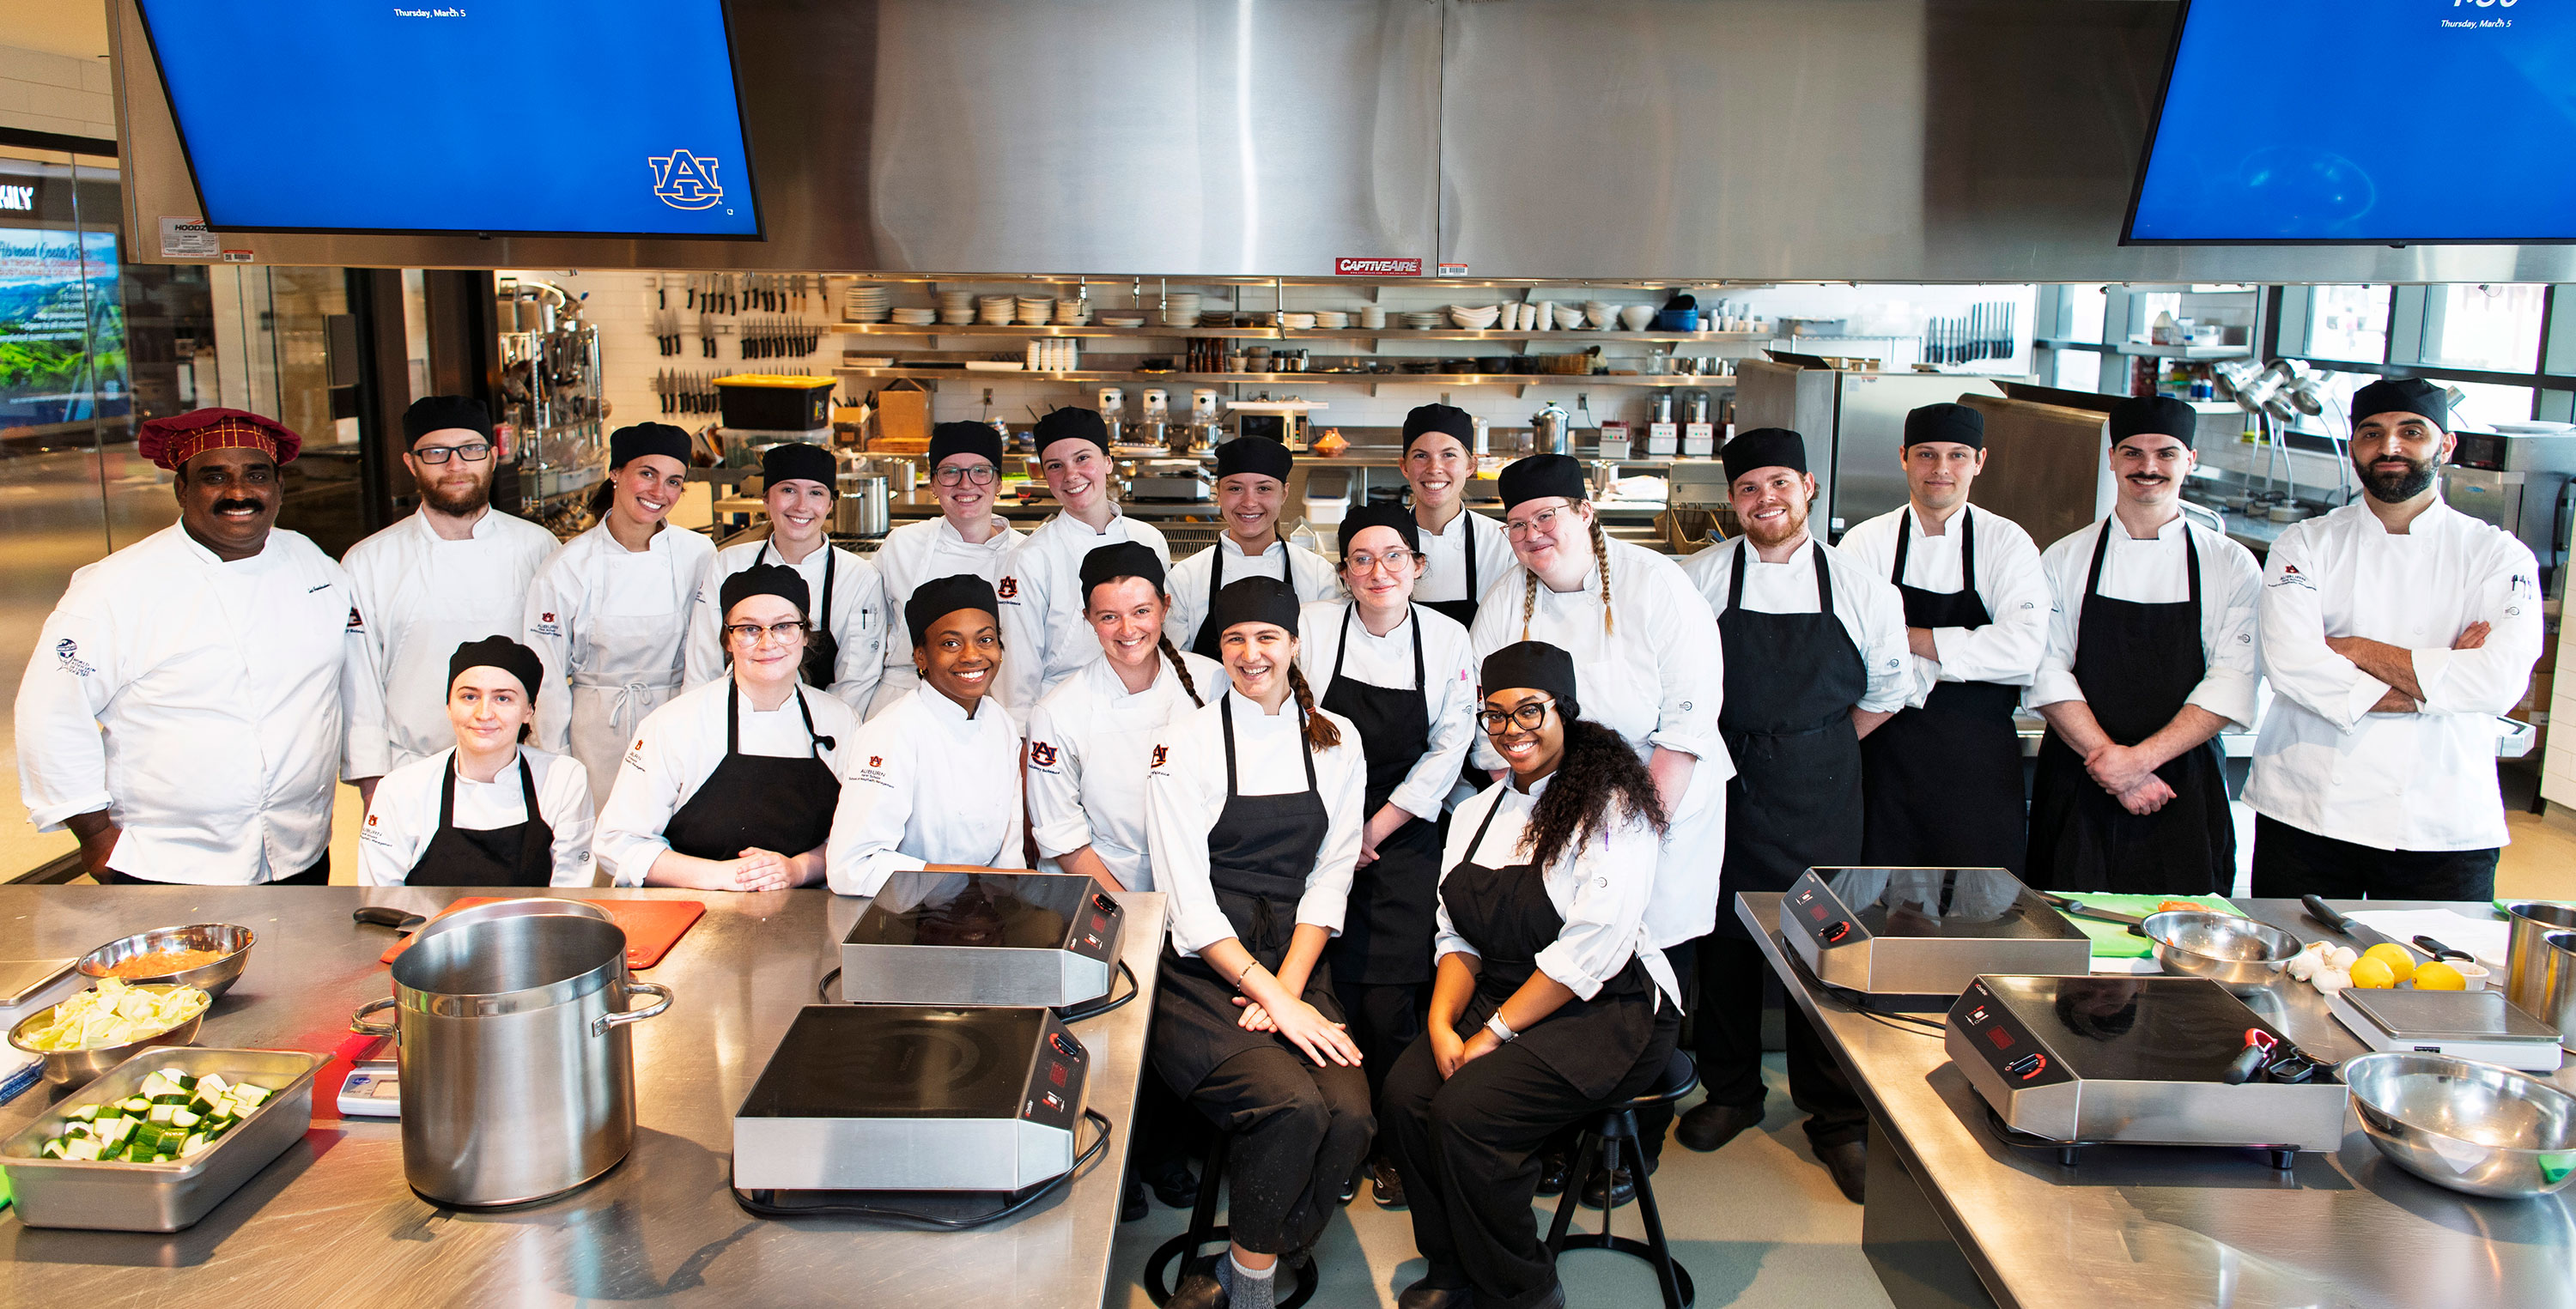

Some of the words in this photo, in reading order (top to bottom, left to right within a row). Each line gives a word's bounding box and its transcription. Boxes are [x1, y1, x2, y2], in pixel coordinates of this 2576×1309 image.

[394, 9, 433, 18] Thursday,
[434, 9, 459, 17] March
[2441, 20, 2477, 29] Thursday,
[2479, 19, 2505, 27] March
